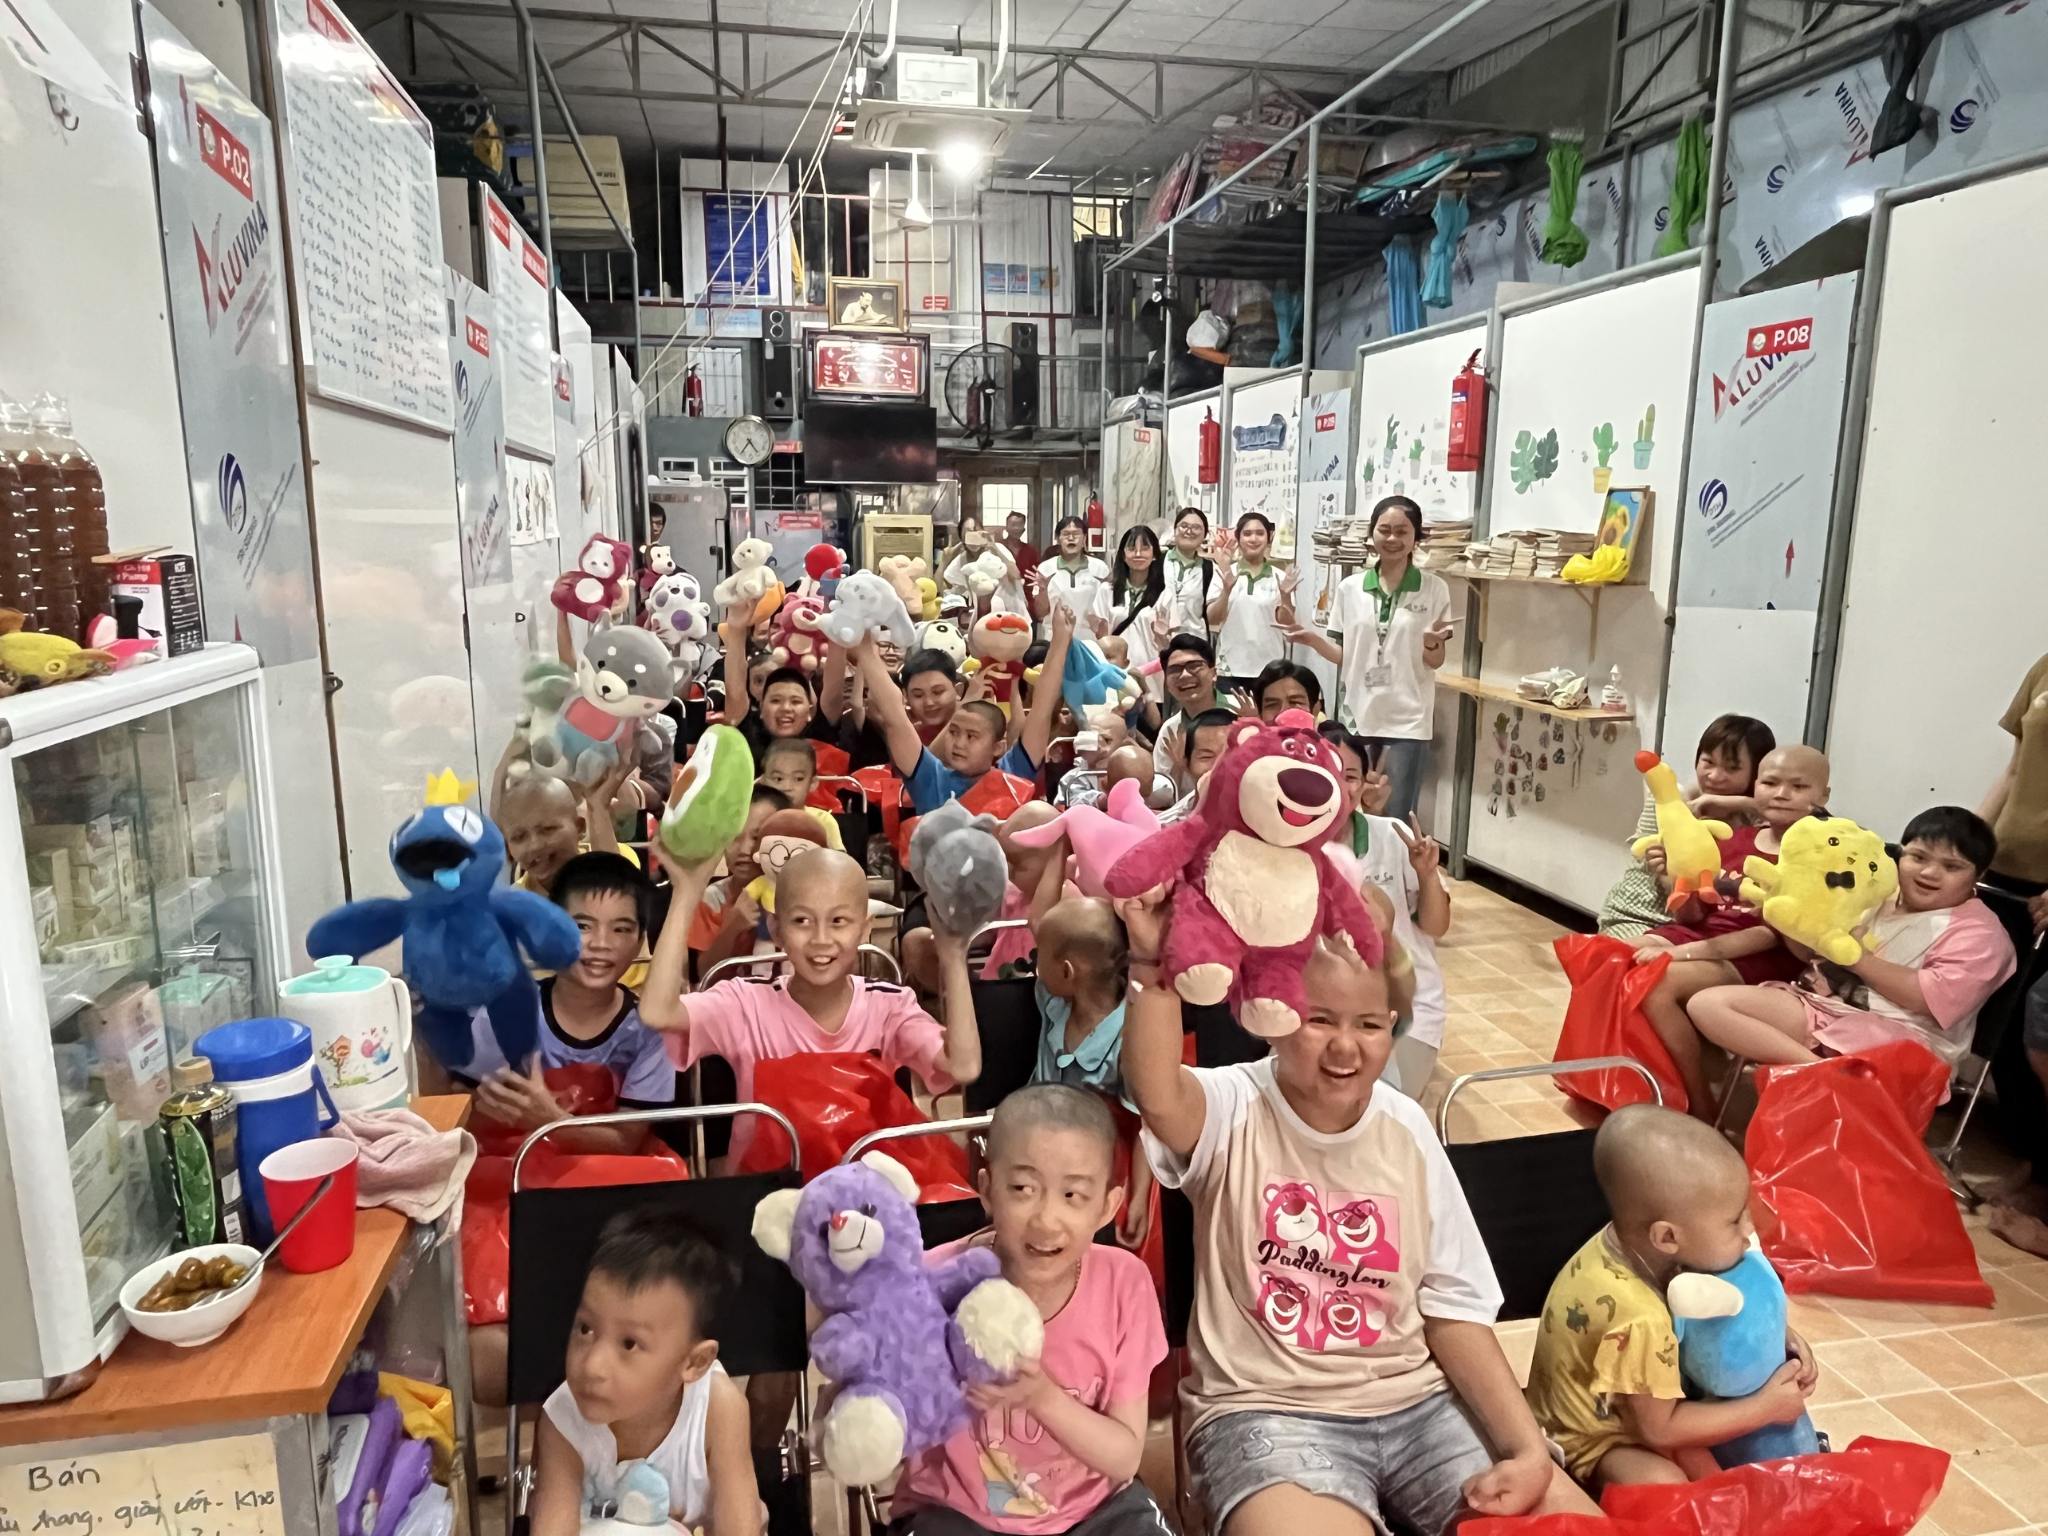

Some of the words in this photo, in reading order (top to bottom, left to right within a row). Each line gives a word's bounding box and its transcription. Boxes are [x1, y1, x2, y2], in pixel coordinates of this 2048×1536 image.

[220, 136, 251, 188] P.02
[192, 200, 269, 338] ALUVINA
[1773, 325, 1810, 348] P.08
[1713, 351, 1790, 423] ALUV
[28, 1461, 101, 1491] Bán
